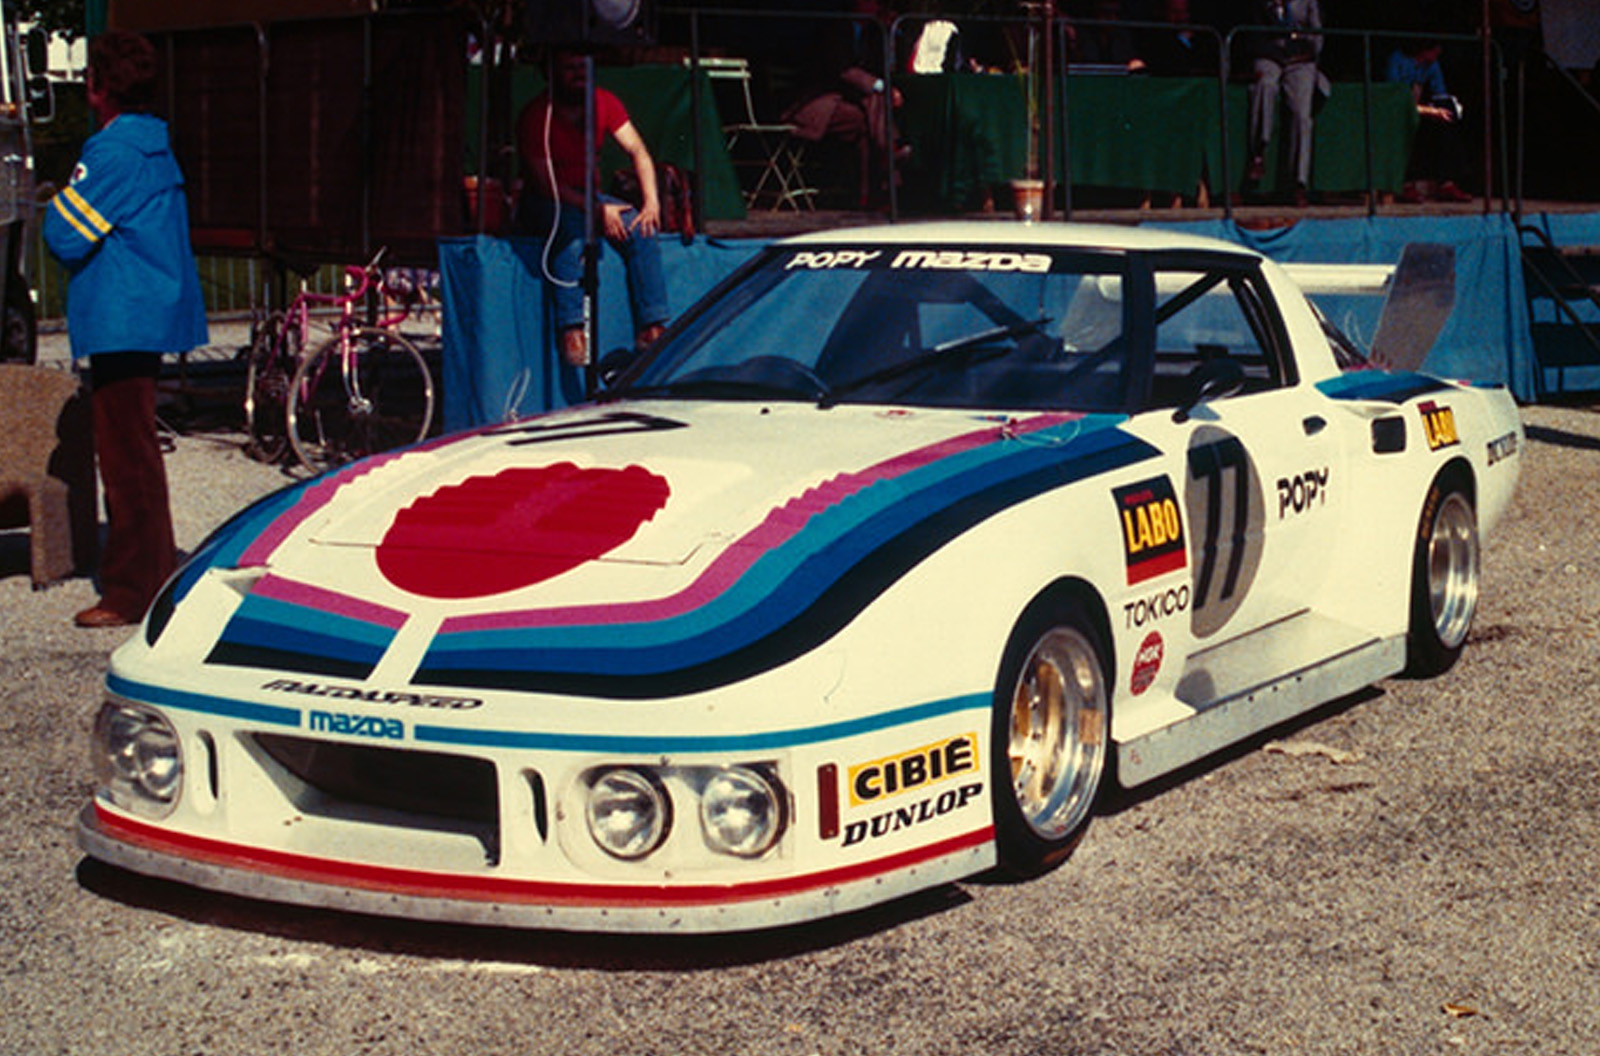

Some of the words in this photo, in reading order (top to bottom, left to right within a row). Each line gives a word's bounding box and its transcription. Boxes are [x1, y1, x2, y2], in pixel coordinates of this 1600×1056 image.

[785, 251, 882, 270] POPY
[891, 251, 1051, 273] mazda
[1277, 466, 1329, 520] POPY
[1123, 498, 1179, 554] LABO
[1187, 436, 1249, 612] 77
[1124, 585, 1189, 630] TOKICO
[309, 710, 404, 740] mazda
[855, 738, 972, 800] CIBIÉ
[841, 783, 984, 848] DUNLOP
